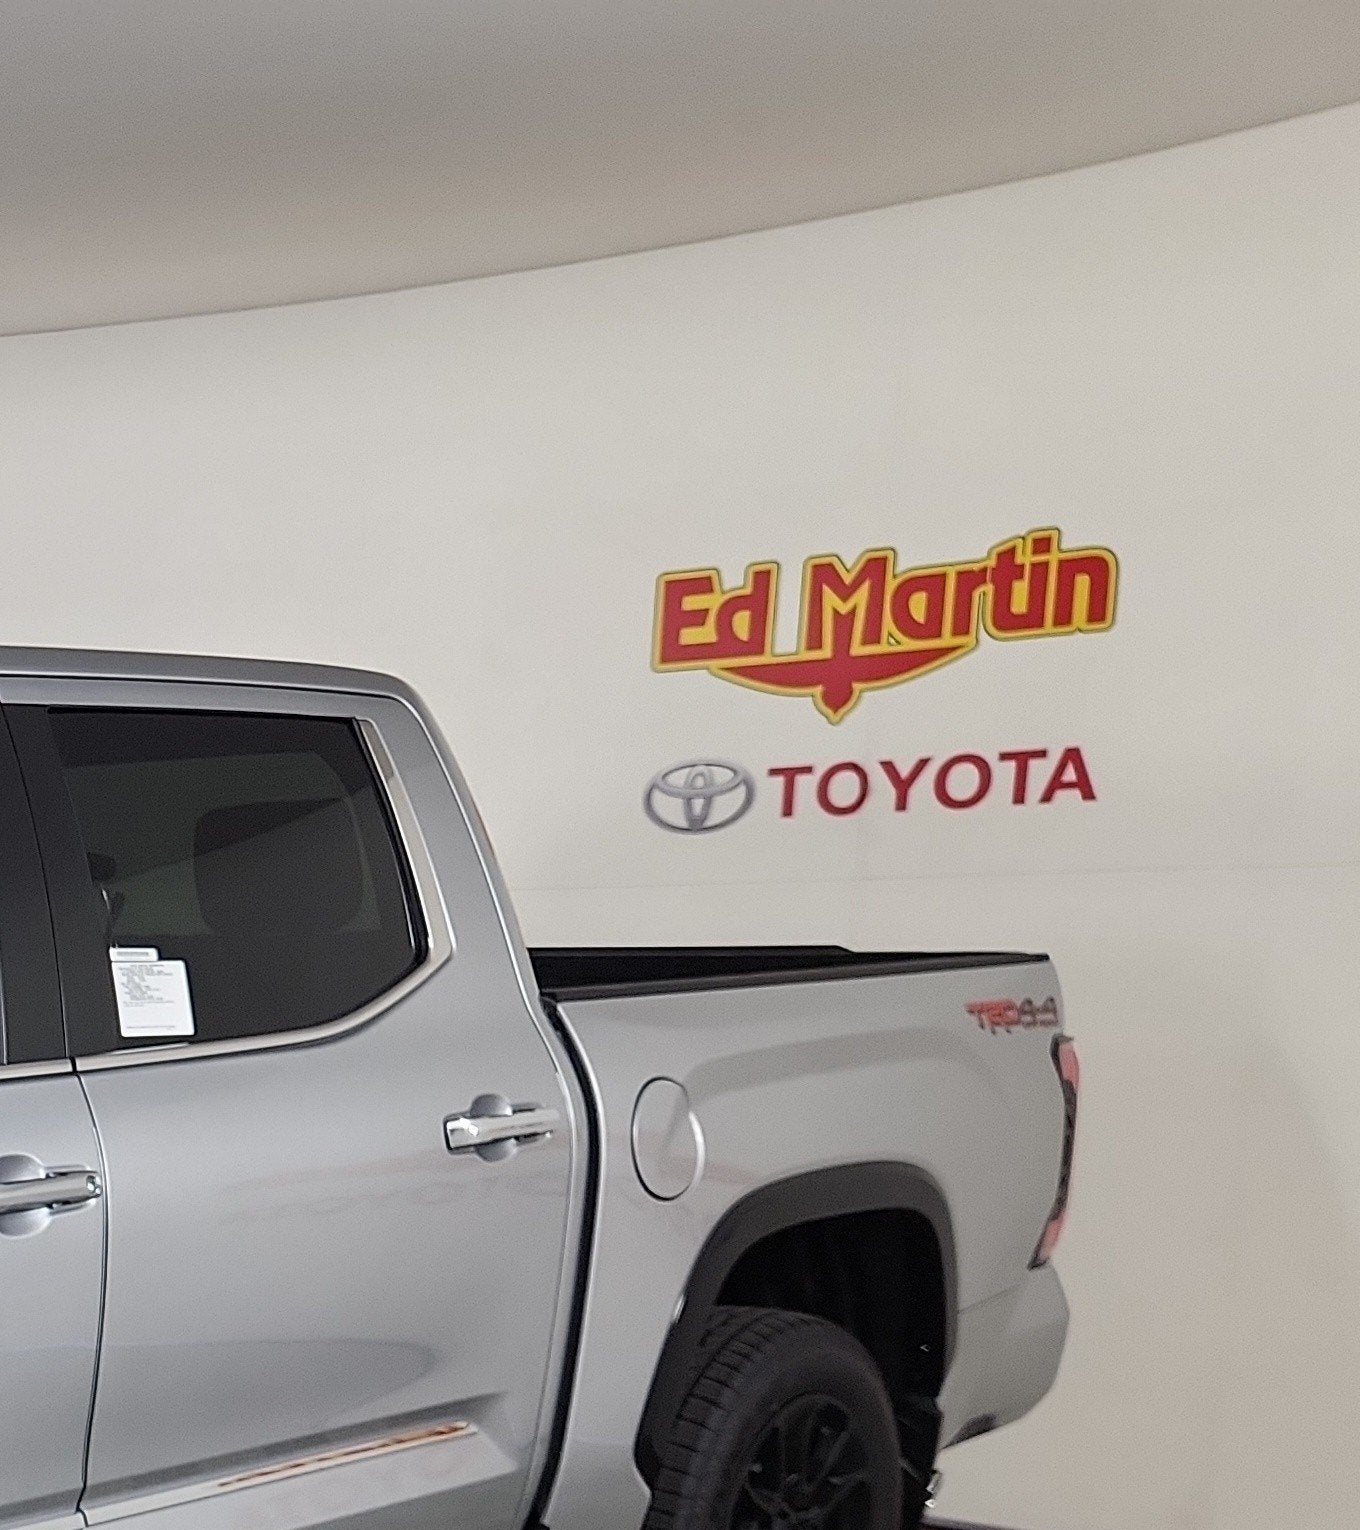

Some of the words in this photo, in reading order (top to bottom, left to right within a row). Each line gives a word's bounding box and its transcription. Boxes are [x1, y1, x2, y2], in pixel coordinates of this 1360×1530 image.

[654, 564, 777, 669] Ed
[800, 529, 1117, 655] Martin
[767, 747, 1097, 818] TOYOTA
